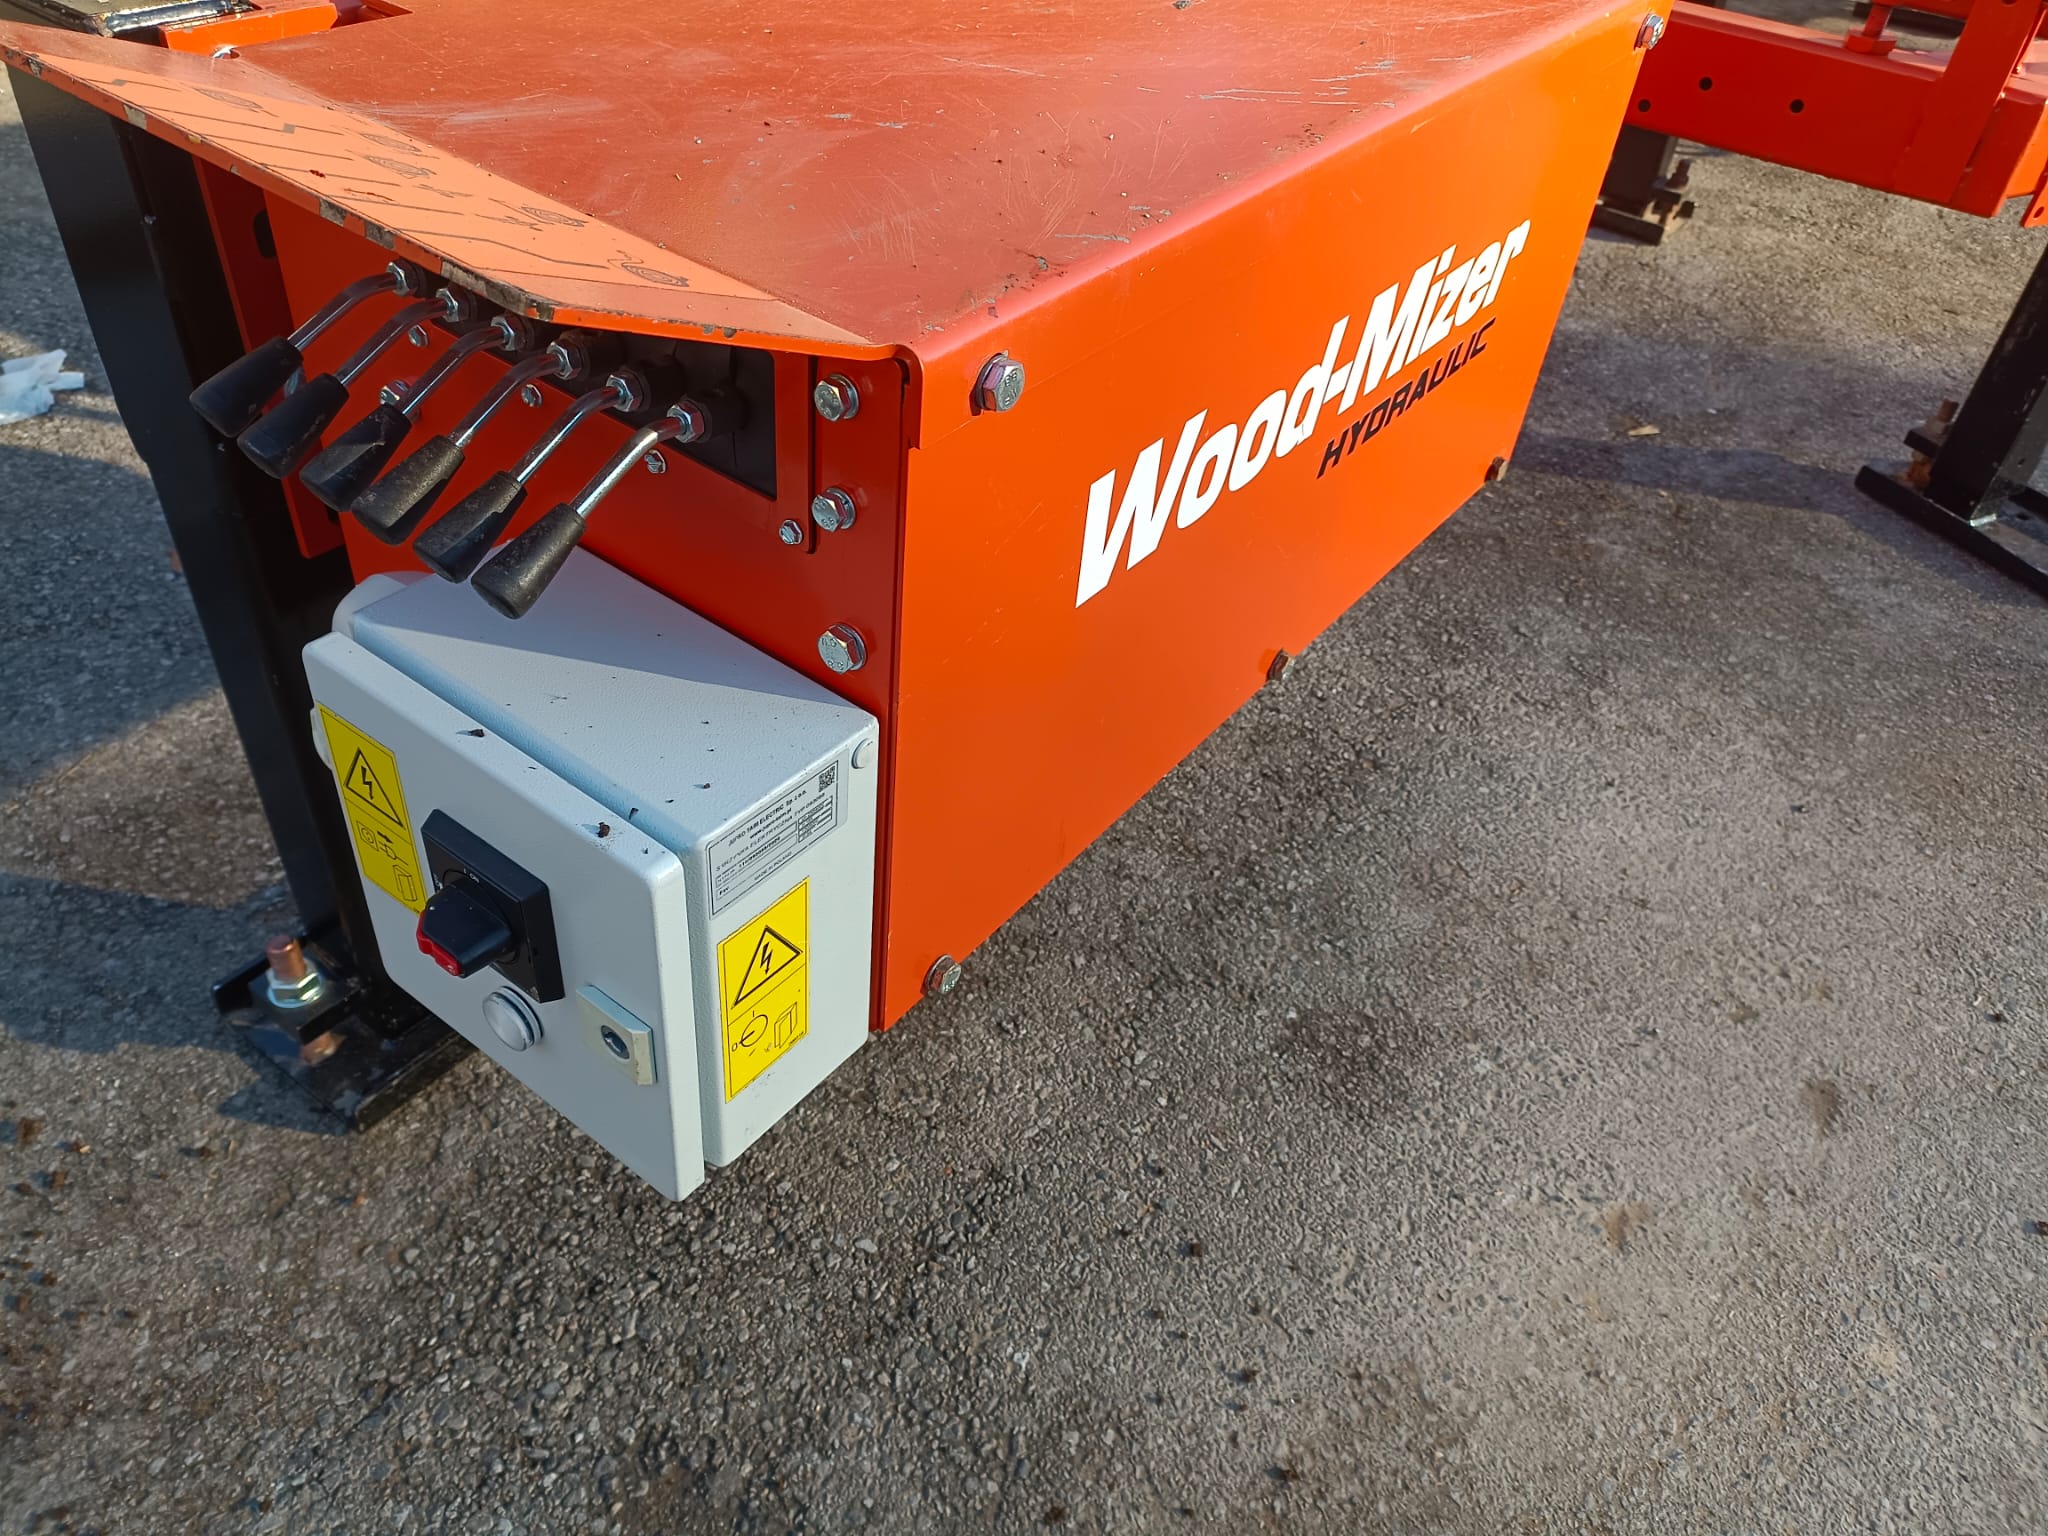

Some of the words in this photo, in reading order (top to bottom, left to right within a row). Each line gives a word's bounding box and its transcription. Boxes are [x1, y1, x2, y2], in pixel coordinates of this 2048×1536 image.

[1074, 219, 1532, 609] Wood-Mizer
[1316, 317, 1496, 479] HYDRAULIC
[759, 804, 784, 825] ELECTRIC
